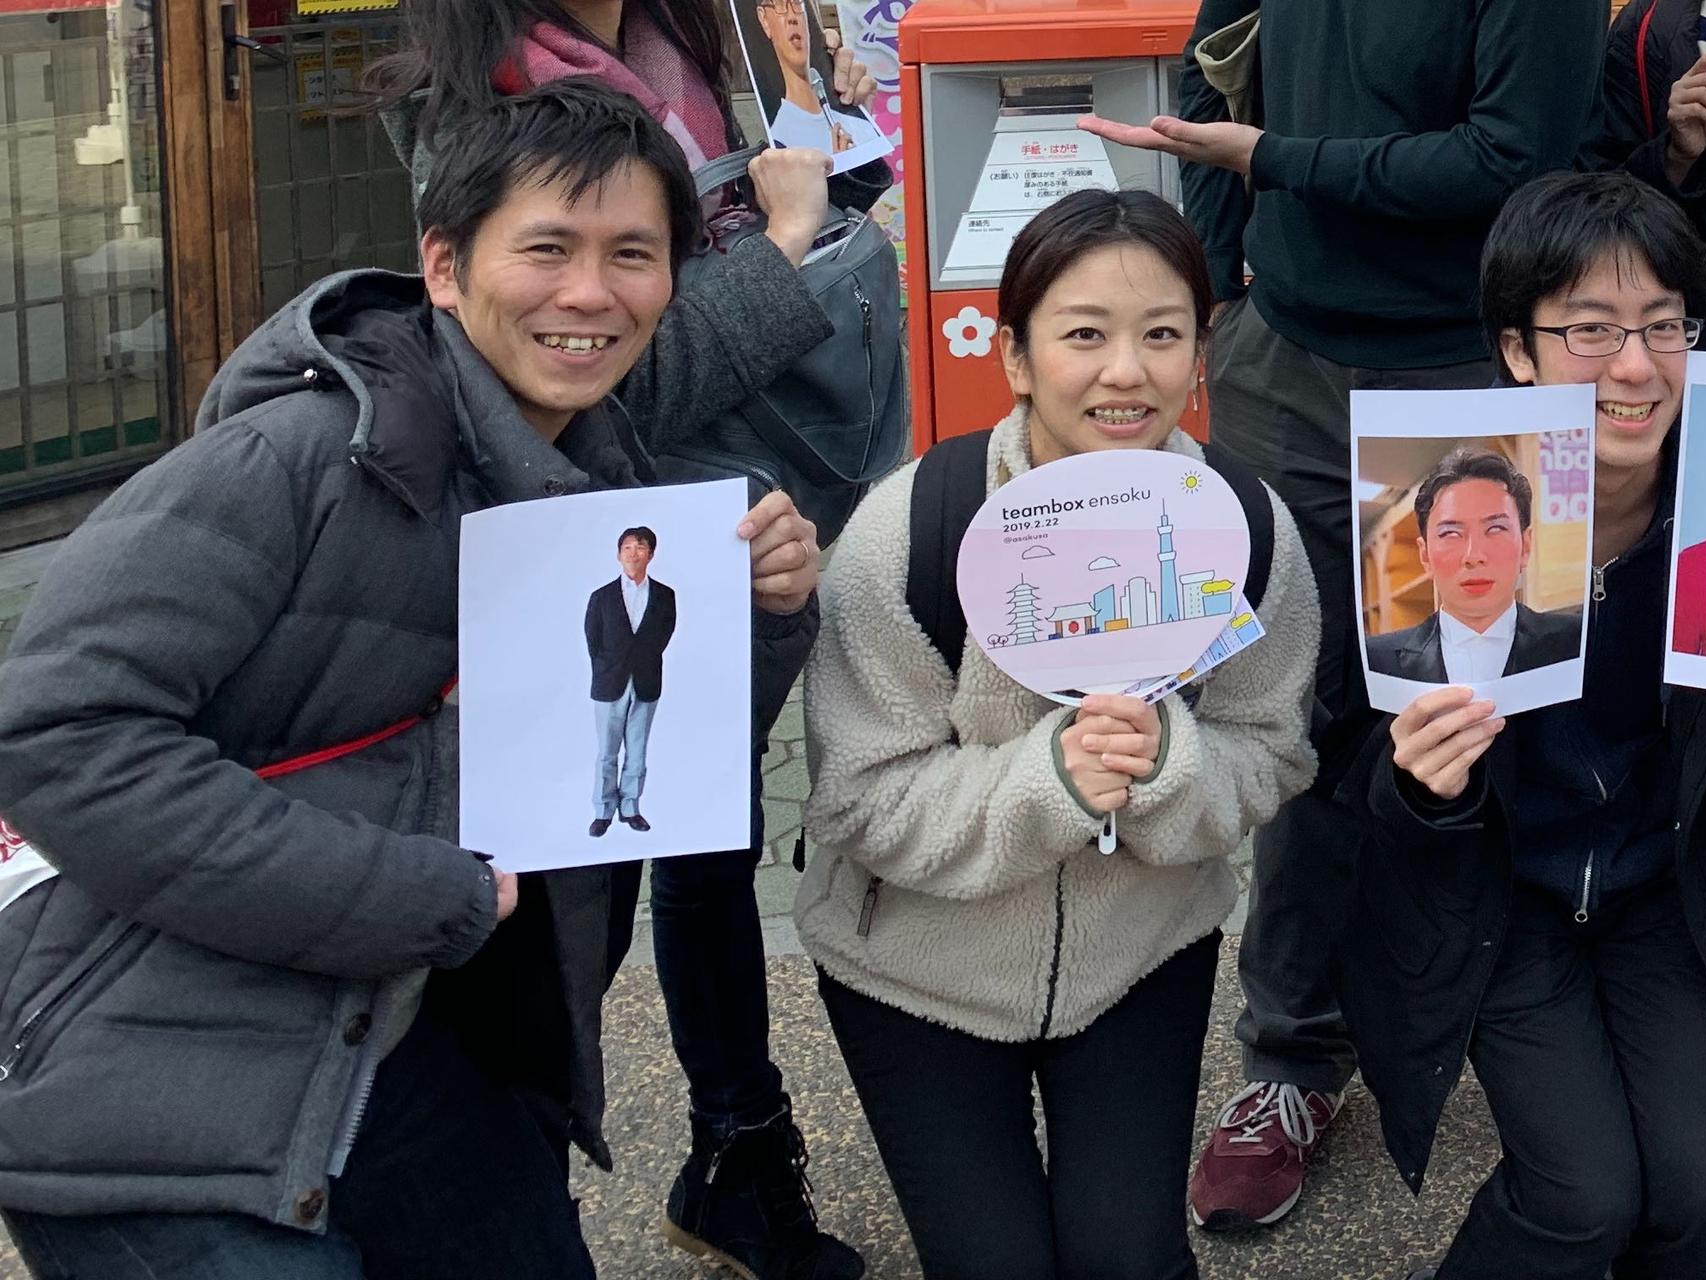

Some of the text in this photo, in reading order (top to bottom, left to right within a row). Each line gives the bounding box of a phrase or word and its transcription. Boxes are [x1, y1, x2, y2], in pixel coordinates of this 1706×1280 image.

[1002, 487, 1152, 521] teambox ensoku
[1003, 517, 1060, 533] 2019.2.22
[1003, 532, 1049, 545] @asakusa
